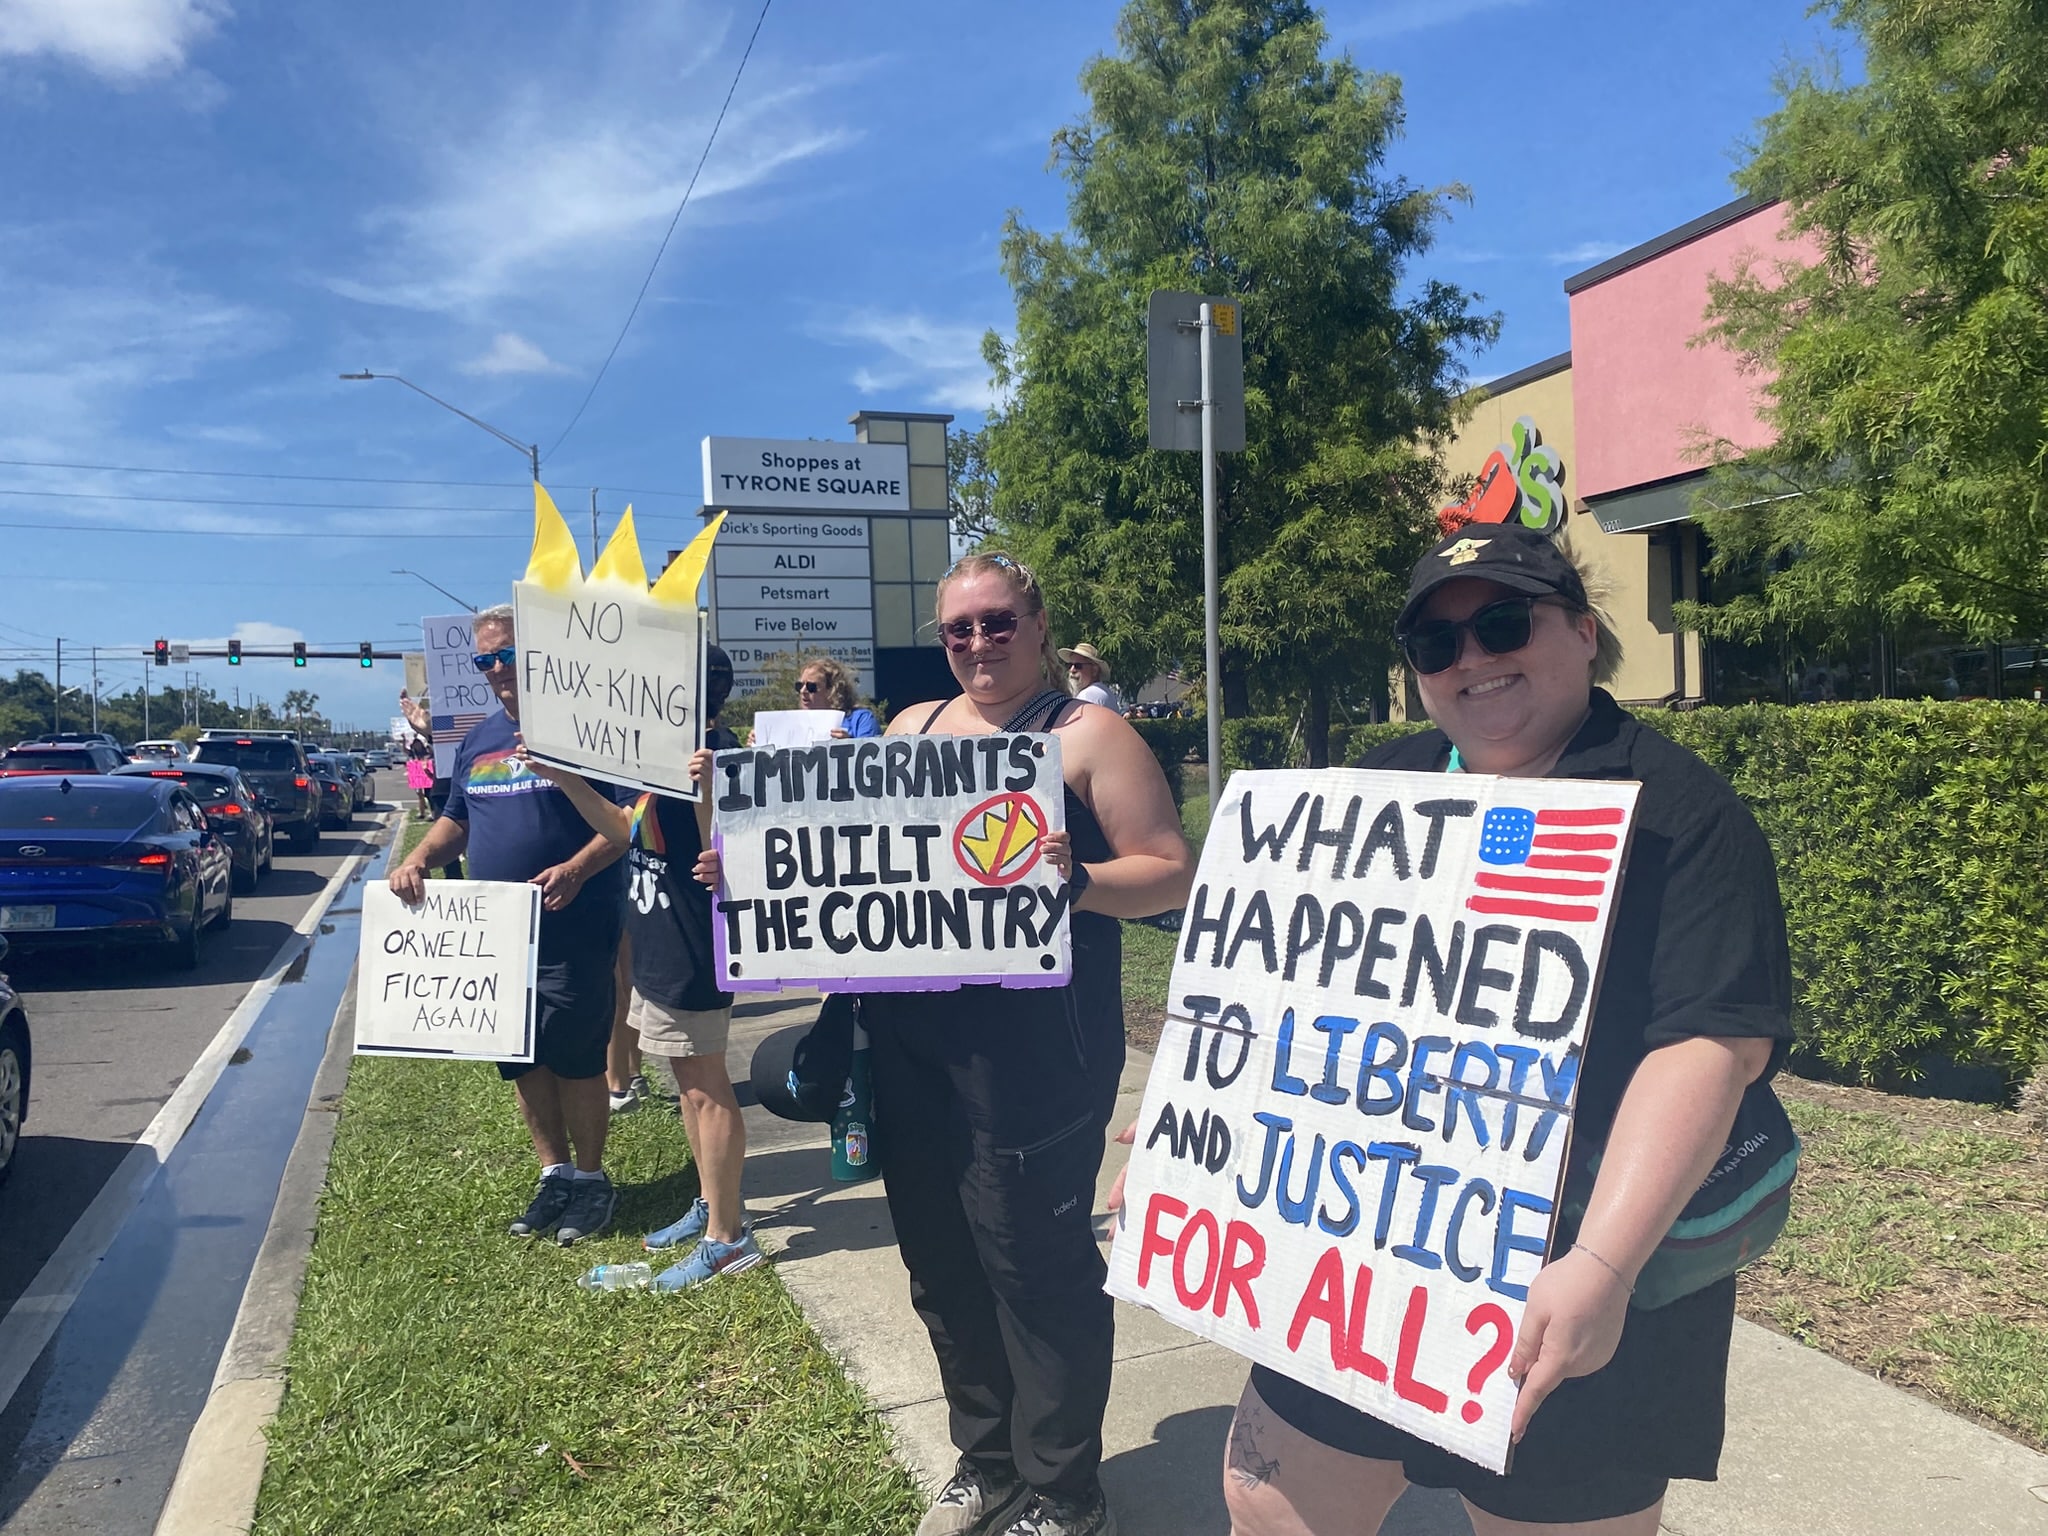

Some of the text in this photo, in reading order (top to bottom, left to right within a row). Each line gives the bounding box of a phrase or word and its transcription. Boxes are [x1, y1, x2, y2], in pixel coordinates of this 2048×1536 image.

[761, 452, 862, 473] Shoppes at
[720, 474, 901, 496] TYRONE SQUARE
[719, 520, 864, 538] Dick's Sporting Goods
[773, 554, 816, 570] ALDI
[760, 585, 830, 601] Petsmart
[566, 601, 623, 644] NO
[754, 617, 838, 632] Five Below
[430, 626, 472, 650] LOV
[850, 646, 872, 657] Best
[440, 652, 482, 677] FRE
[729, 649, 750, 662] TD
[444, 683, 500, 709] PROT
[525, 650, 689, 728] FAUX-KING
[572, 713, 642, 769] WAY!
[467, 784, 511, 795] DUNEDIN
[511, 779, 532, 792] BLUE
[716, 735, 1037, 812] IMMIGRANTS
[1240, 790, 1478, 881] WHAT
[764, 824, 942, 891] BUILT
[423, 895, 487, 923] MAKE
[717, 883, 1071, 955] THE COUNTRY
[383, 929, 497, 959] ORWELL
[1183, 883, 1590, 1042] HAPPENED
[384, 972, 498, 1002] FICTION
[412, 1006, 497, 1034] AGAIN
[1183, 995, 1580, 1162] TO LIBERTY
[1696, 1131, 1770, 1191] HENANDOAH
[1146, 1102, 1554, 1301] AND JUSTICE
[1137, 1192, 1514, 1425] FOR ALL?
